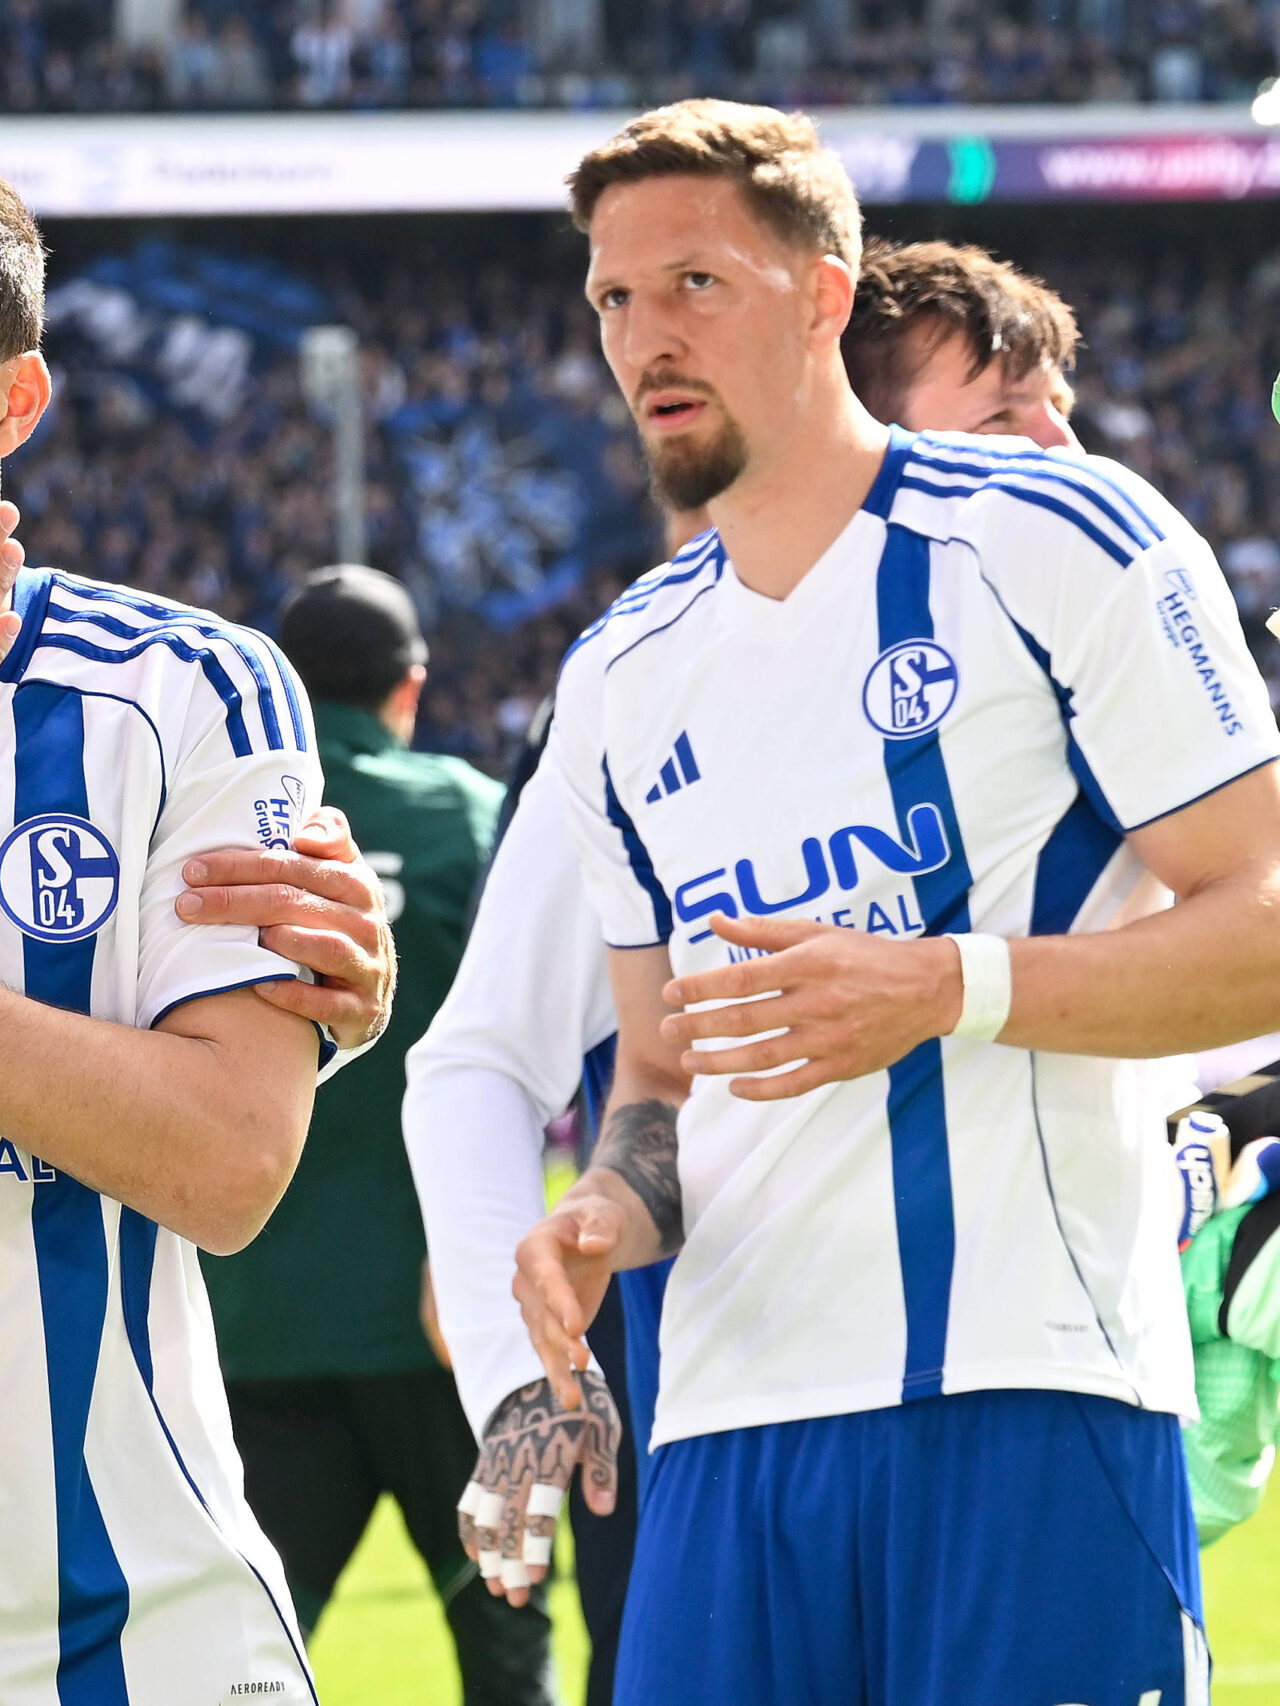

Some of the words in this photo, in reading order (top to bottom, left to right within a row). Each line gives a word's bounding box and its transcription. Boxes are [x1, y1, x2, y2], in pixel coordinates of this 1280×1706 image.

[1164, 592, 1244, 736] HEGMANNS
[254, 799, 273, 849] Grupp
[674, 802, 951, 944] SUN
[230, 1681, 286, 1696] AEROREADY
